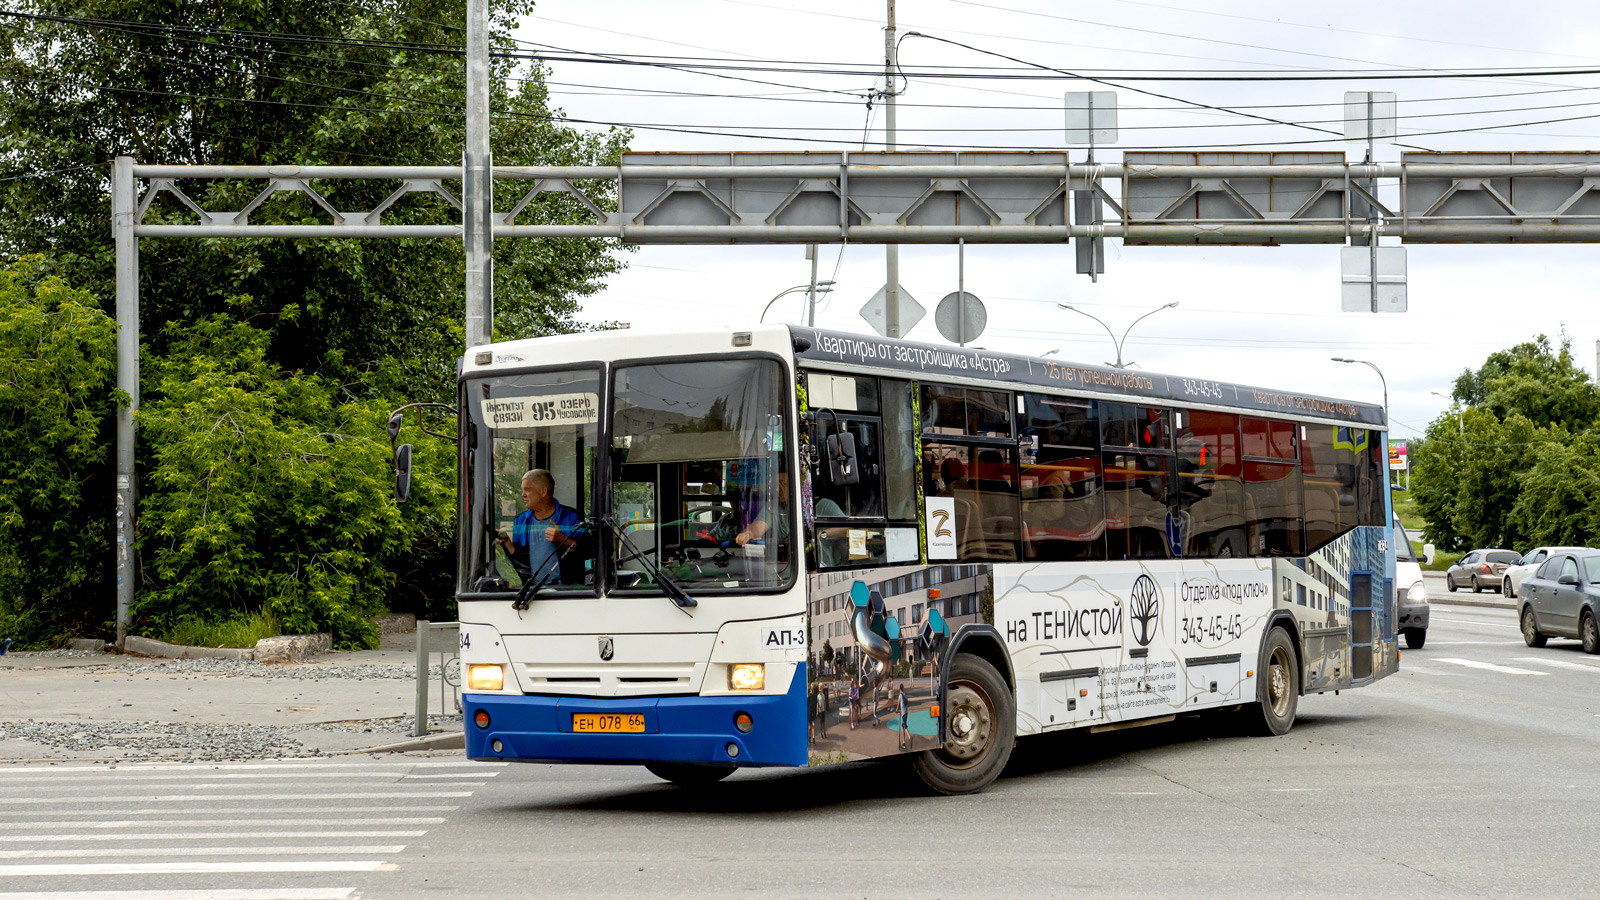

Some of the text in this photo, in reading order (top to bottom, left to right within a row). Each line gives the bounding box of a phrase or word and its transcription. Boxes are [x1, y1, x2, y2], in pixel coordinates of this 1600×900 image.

[814, 331, 1011, 377] Квартиры от застройщика «Астра»
[1061, 366, 1076, 381] лет
[1078, 367, 1122, 388] успешной
[1122, 372, 1154, 393] работы
[1183, 379, 1223, 399] 343-45-45
[532, 401, 556, 421] 95
[560, 398, 591, 409] ОЗЕРО
[1253, 388, 1359, 419] Квартиры от застройщика «Астра»
[493, 412, 524, 423] СВЯЗИ
[1181, 581, 1269, 604] Отделка «под ключ»
[1006, 600, 1122, 643] на ТЕНИСТОЙ
[1181, 614, 1242, 644] 343-45-45
[766, 630, 805, 646] АП-3
[599, 716, 622, 730] 078
[628, 715, 641, 726] 66
